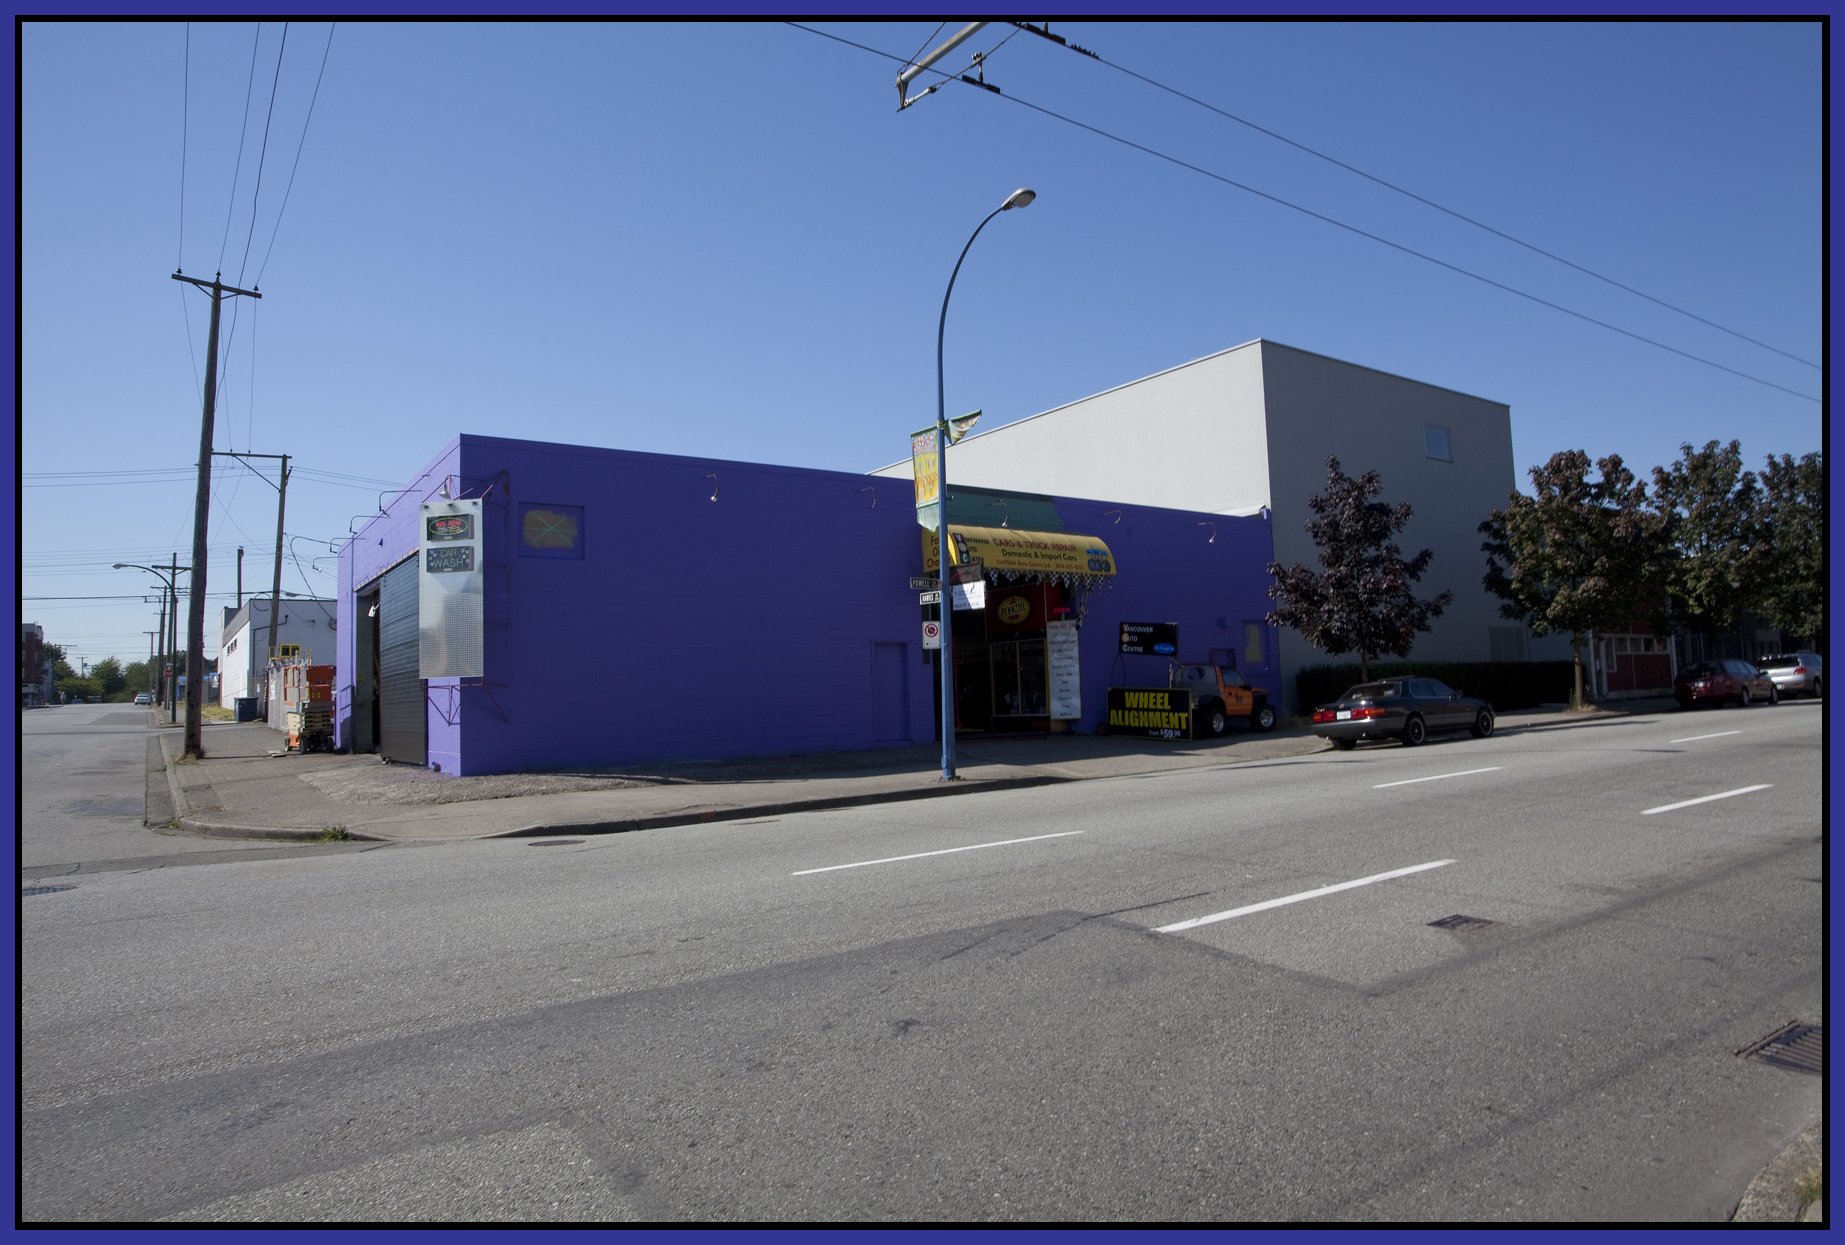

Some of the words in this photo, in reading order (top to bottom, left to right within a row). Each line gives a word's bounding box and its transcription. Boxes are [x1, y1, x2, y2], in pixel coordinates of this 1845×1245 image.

[993, 538, 1015, 548] CARS
[1016, 540, 1023, 548] &
[1023, 541, 1050, 550] TRUCK
[1051, 543, 1077, 552] REPAIR
[440, 549, 457, 558] CAR
[1002, 548, 1033, 559] Domestic
[1040, 552, 1061, 562] Import
[1062, 553, 1078, 562] Cars
[433, 558, 464, 568] WASH
[912, 579, 930, 588] POWELL
[1001, 602, 1026, 617] PENNZOIL
[1123, 624, 1153, 633] VANCOUVER
[1122, 643, 1143, 653] CENTRE
[1124, 691, 1171, 710] WHEEL
[1110, 709, 1189, 730] ALIGNMENT
